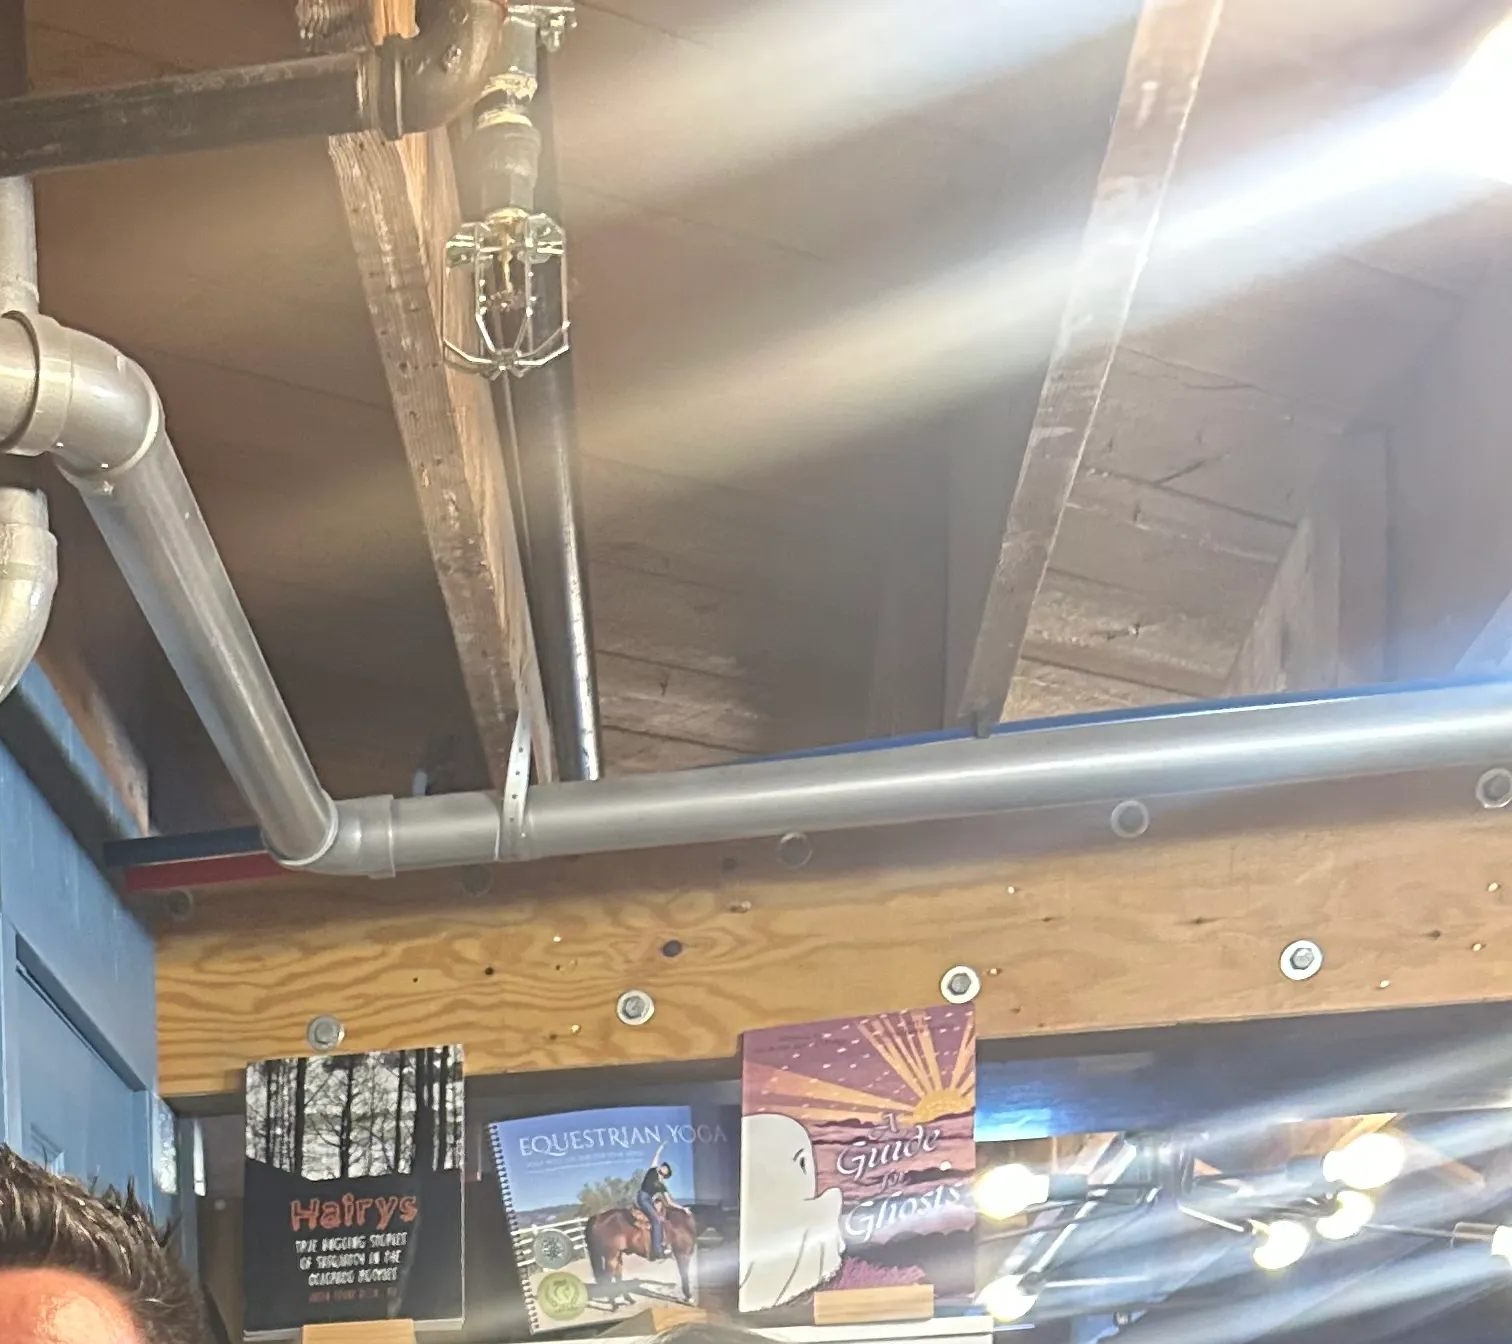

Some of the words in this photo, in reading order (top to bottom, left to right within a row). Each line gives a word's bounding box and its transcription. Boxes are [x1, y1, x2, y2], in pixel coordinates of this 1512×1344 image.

[519, 1124, 660, 1157] EQUESTRIAN
[665, 1123, 729, 1144] YOGA
[837, 1125, 941, 1182] Guide
[290, 1193, 418, 1231] Hairys
[845, 1181, 966, 1243] Ghosts
